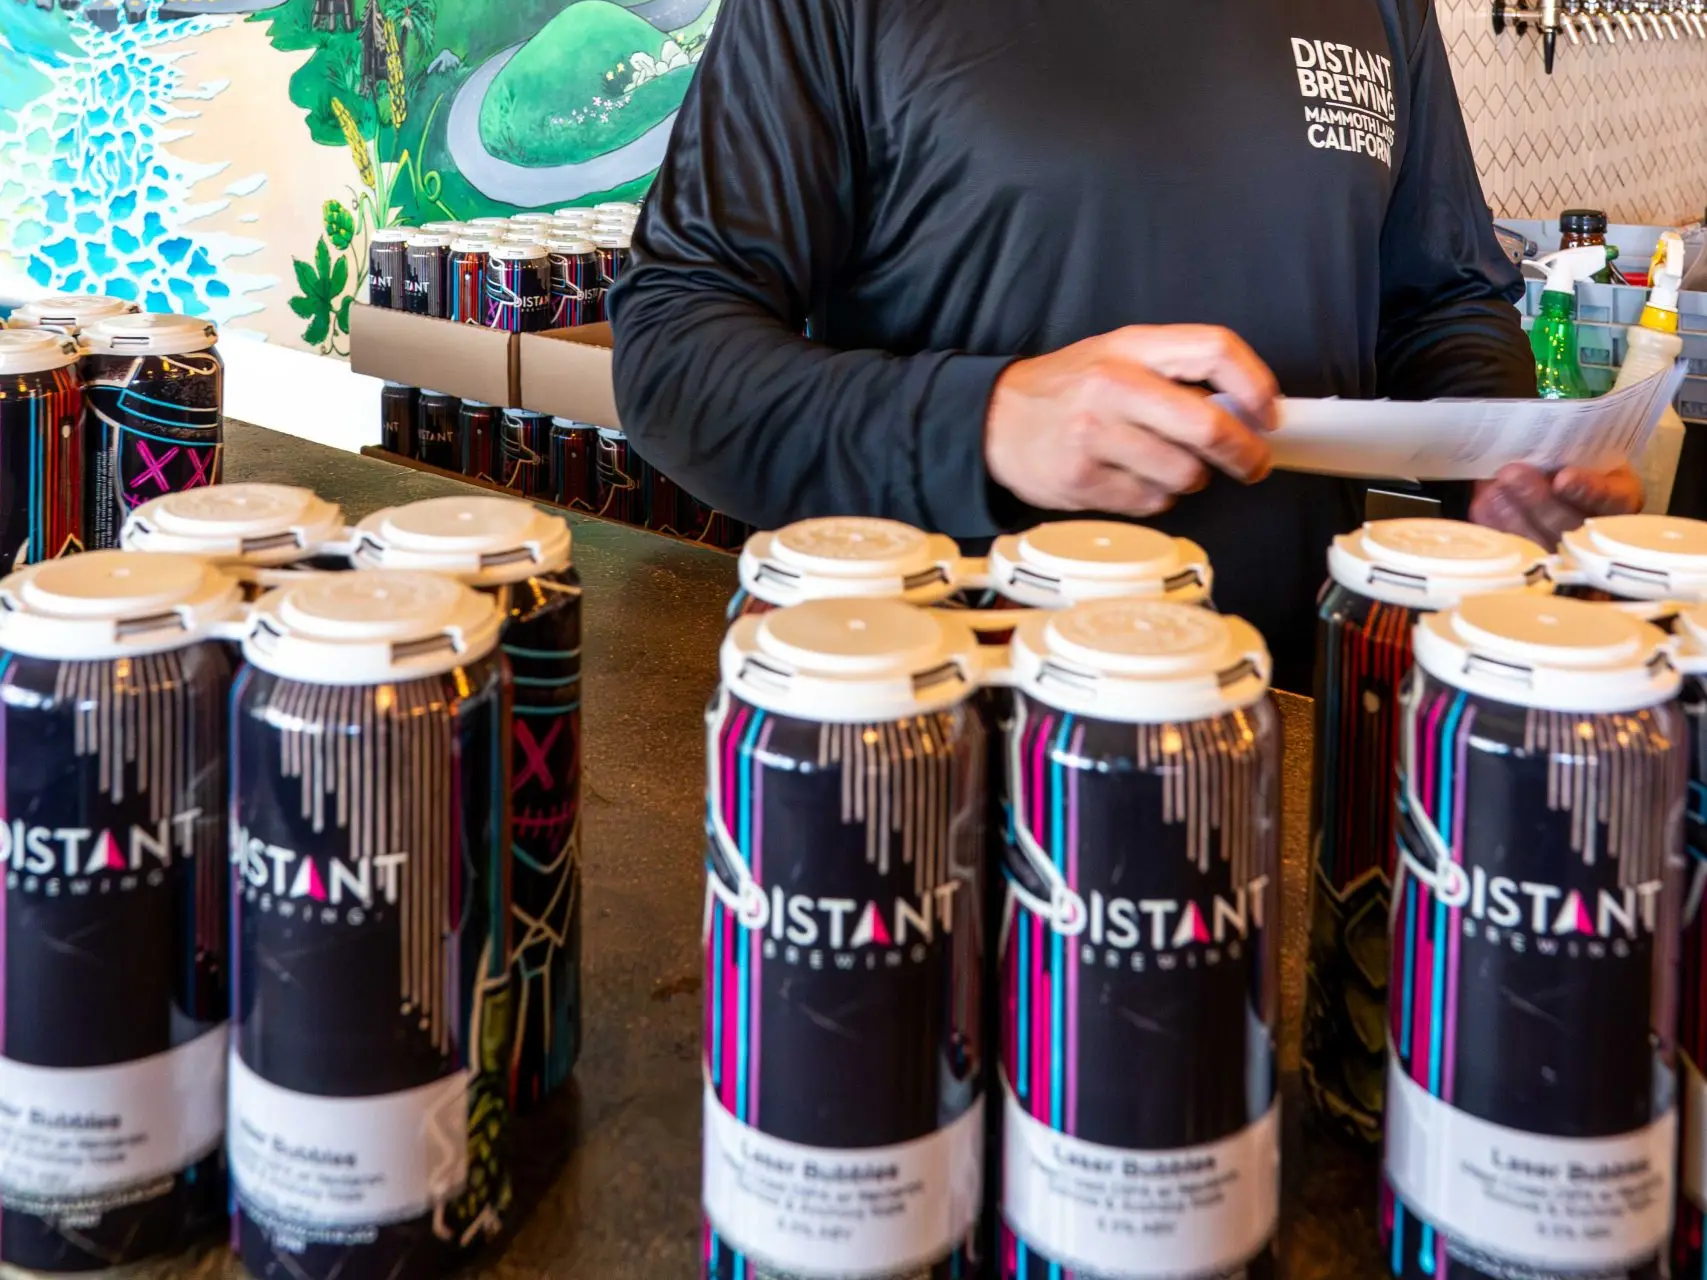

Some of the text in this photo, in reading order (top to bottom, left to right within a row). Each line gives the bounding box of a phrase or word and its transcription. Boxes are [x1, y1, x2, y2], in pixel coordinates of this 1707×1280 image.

[1290, 37, 1391, 90] DISTANT
[1297, 68, 1396, 122] BREWING
[1304, 105, 1375, 133] MAMMOTH
[1307, 123, 1392, 169] CALIFORN
